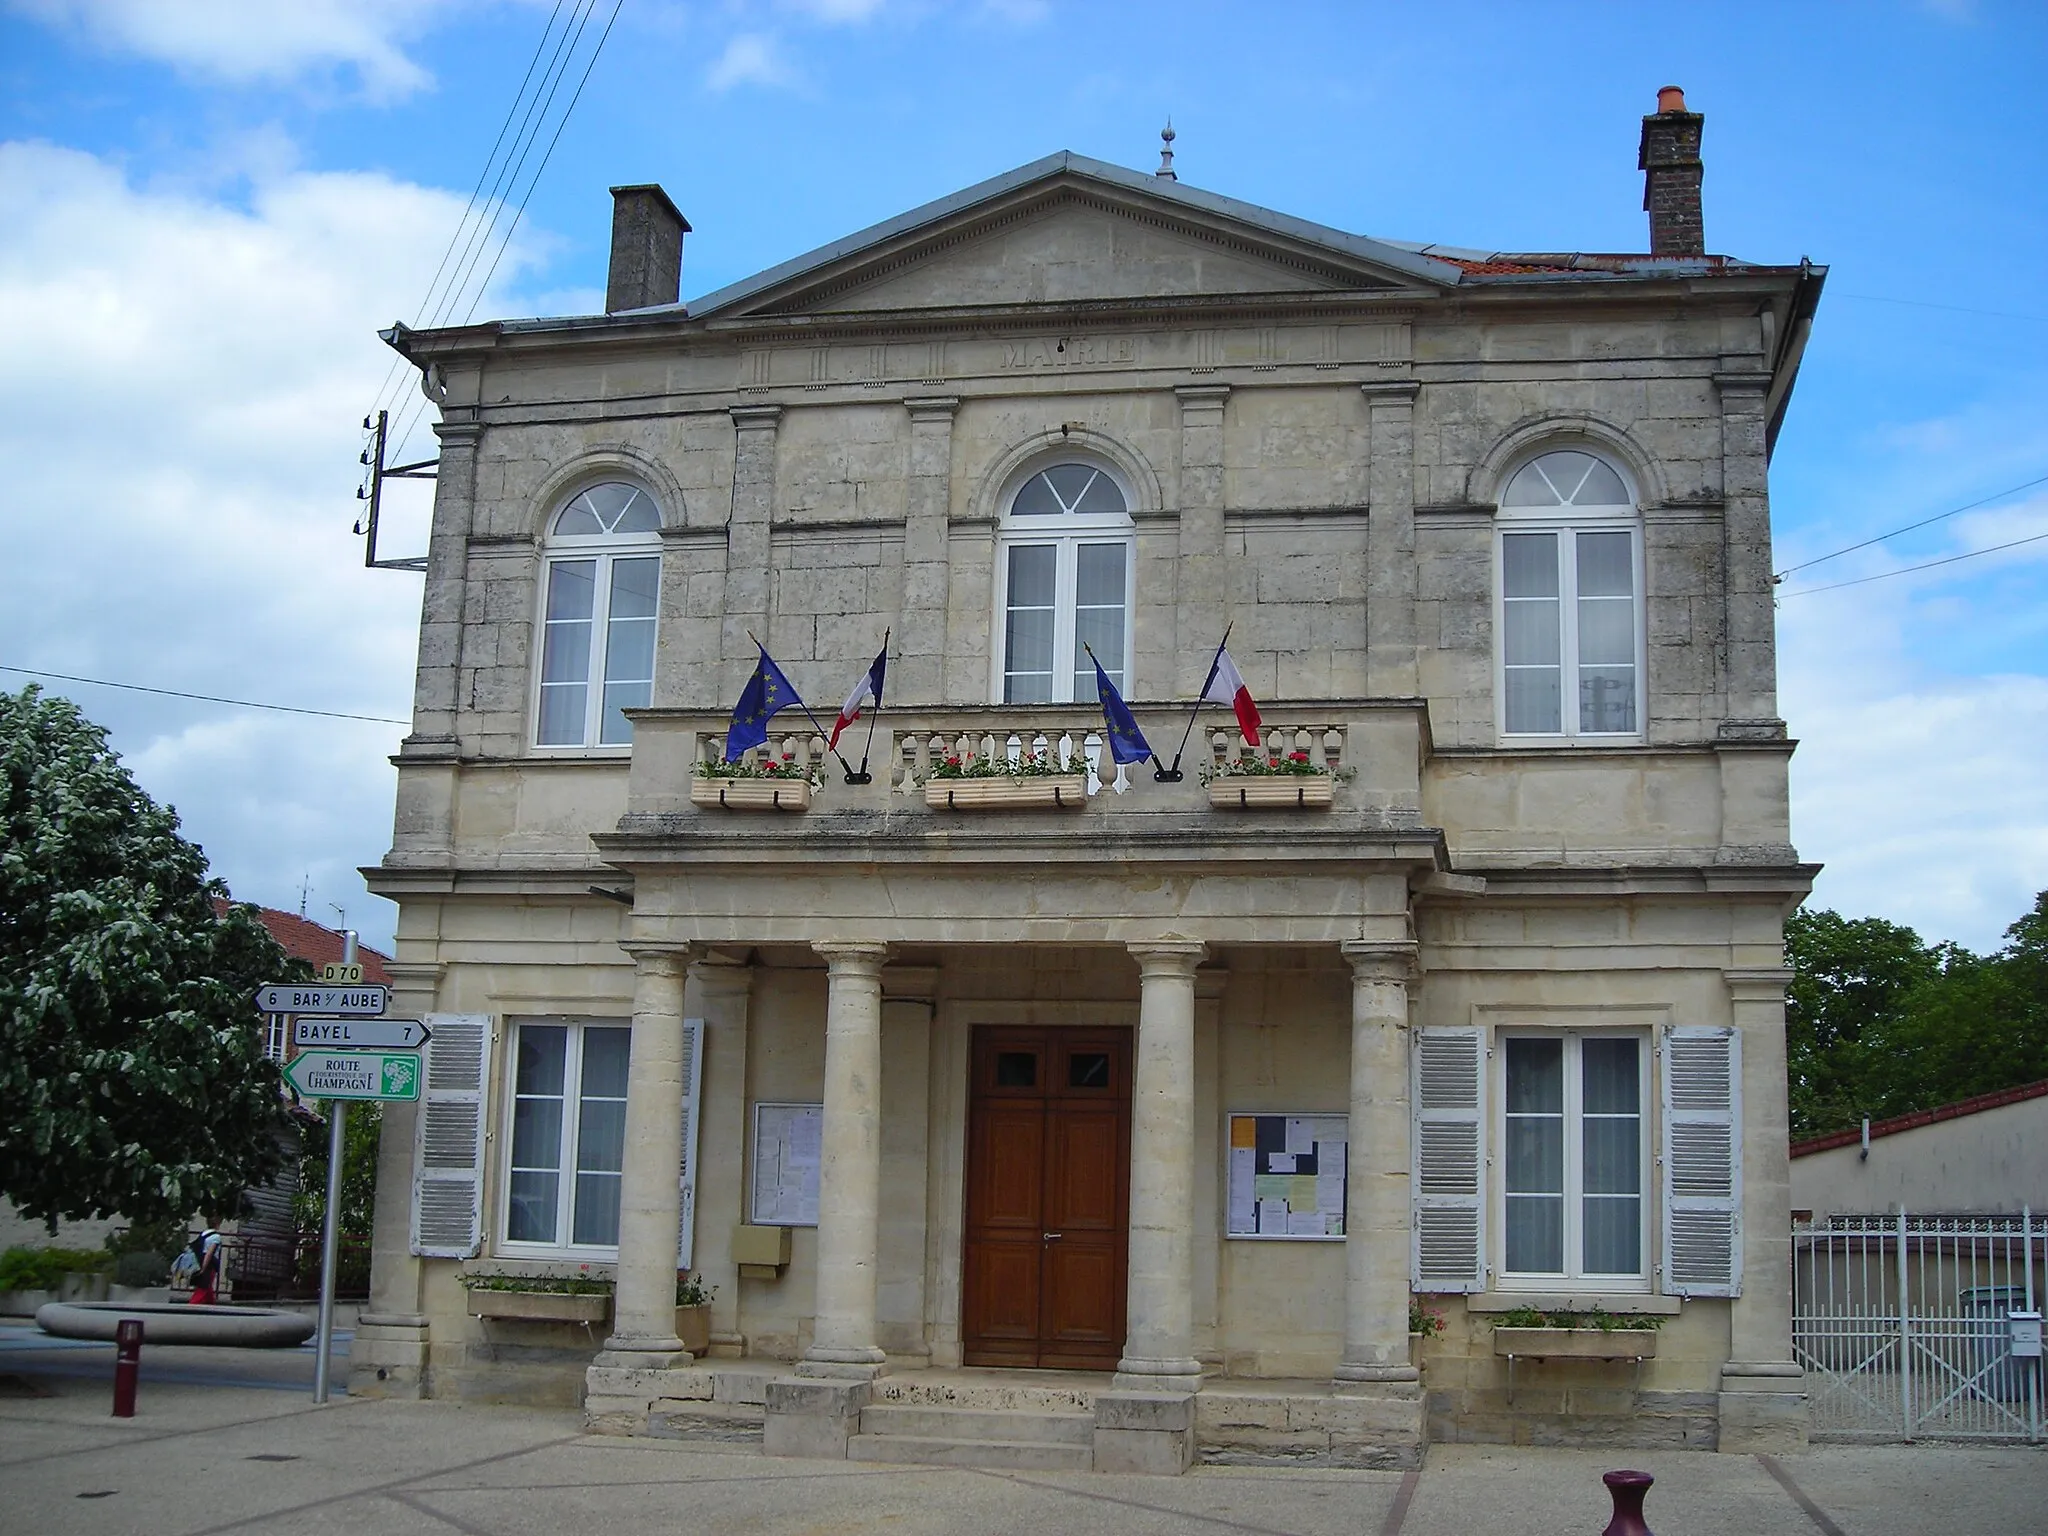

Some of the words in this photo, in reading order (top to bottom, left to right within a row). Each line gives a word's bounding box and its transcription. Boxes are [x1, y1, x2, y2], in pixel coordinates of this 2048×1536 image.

[1000, 338, 1135, 368] MAIRIE
[326, 967, 335, 979] D
[340, 967, 359, 980] 70
[269, 992, 277, 1005] 6
[293, 993, 321, 1006] BAR
[341, 994, 379, 1007] AUBE
[300, 1026, 350, 1039] BAYEL
[404, 1027, 412, 1040] 7
[326, 1060, 361, 1071] ROUTE
[308, 1071, 373, 1090] CHAMPAGNE
